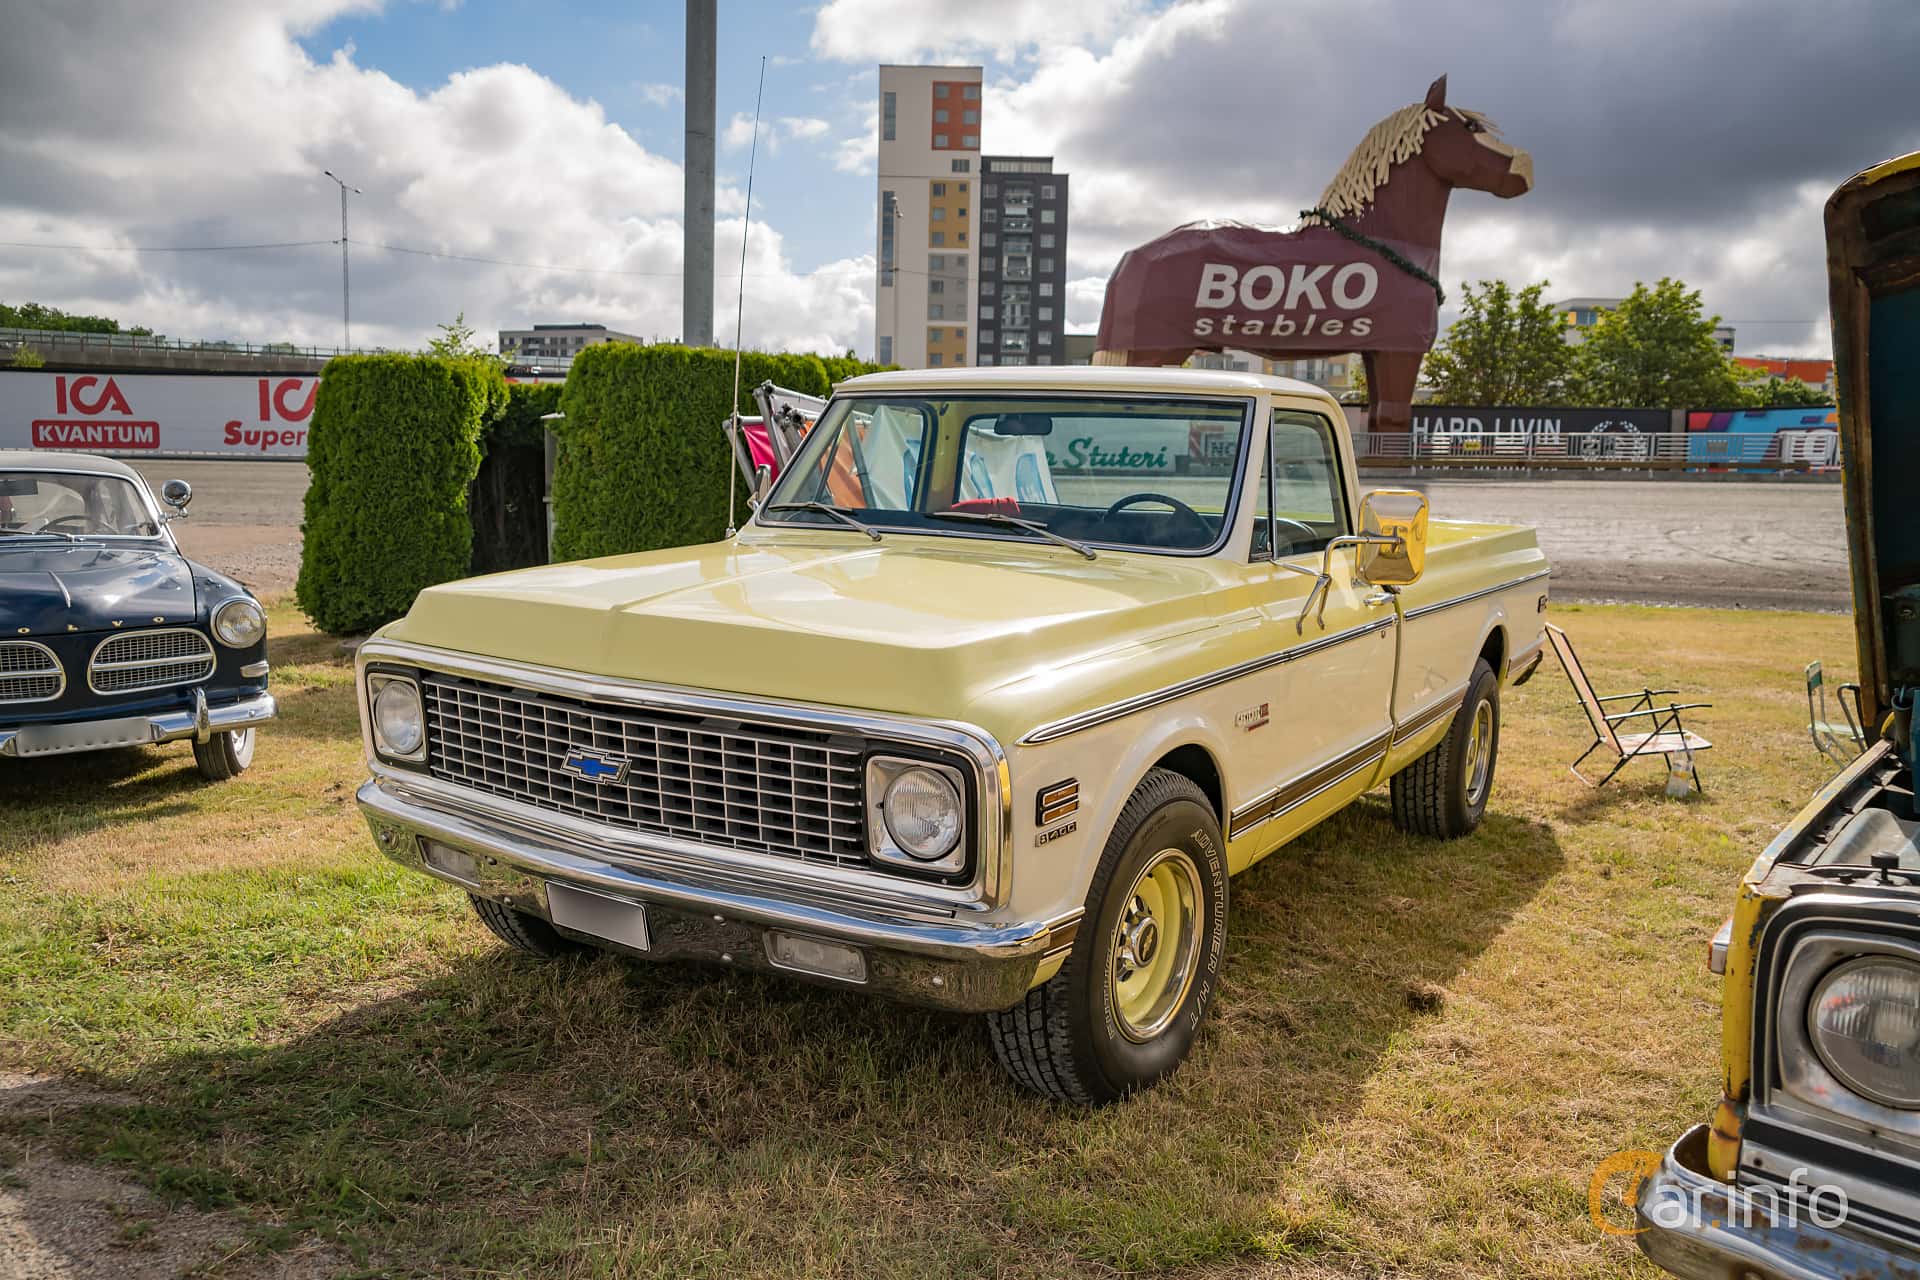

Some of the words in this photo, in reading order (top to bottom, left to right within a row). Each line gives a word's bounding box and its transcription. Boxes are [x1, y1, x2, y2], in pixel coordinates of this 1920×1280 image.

[1195, 262, 1379, 311] BOKO
[1193, 314, 1373, 337] stables
[55, 376, 134, 416] ICA
[38, 424, 154, 443] KVANTUM
[1413, 416, 1483, 444] HARD
[1062, 436, 1168, 468] Stuteri
[17, 615, 166, 634] OLVO
[1190, 828, 1224, 975] ADVENTURER
